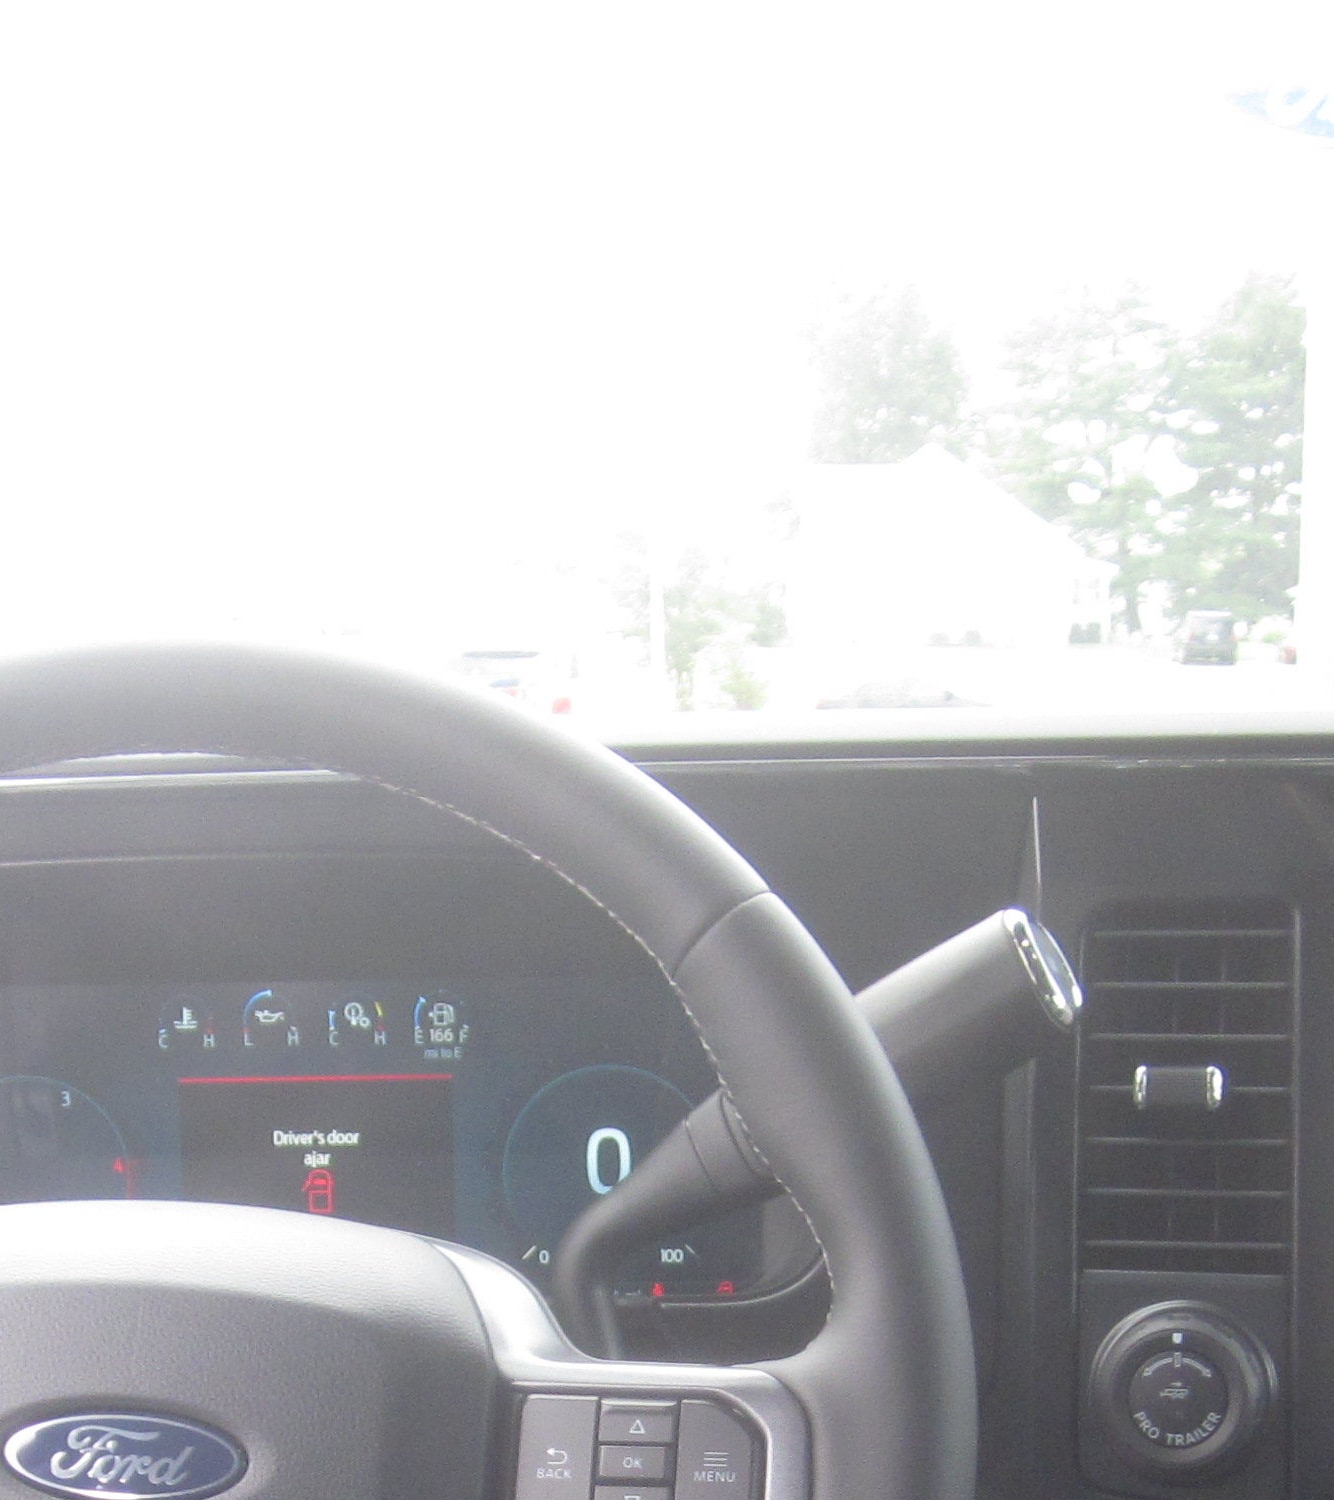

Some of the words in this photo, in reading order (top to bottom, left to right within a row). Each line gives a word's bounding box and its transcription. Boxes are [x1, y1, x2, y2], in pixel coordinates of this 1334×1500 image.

[203, 1033, 216, 1048] H
[287, 1031, 300, 1046] H
[374, 1030, 387, 1046] H
[429, 1027, 454, 1043] 166
[60, 1090, 71, 1107] 3
[272, 1128, 325, 1146] Driver's
[326, 1129, 360, 1145] door
[112, 1156, 124, 1174] 4
[303, 1149, 331, 1168] ajar
[586, 1126, 632, 1195] 0
[538, 1249, 550, 1264] 0
[659, 1248, 685, 1263] 100
[1132, 1411, 1160, 1440] PRO
[1166, 1412, 1222, 1447] TRAILER
[50, 1424, 195, 1486] Ford
[622, 1456, 643, 1469] OK
[536, 1467, 572, 1480] BACK
[693, 1470, 737, 1483] MENU
